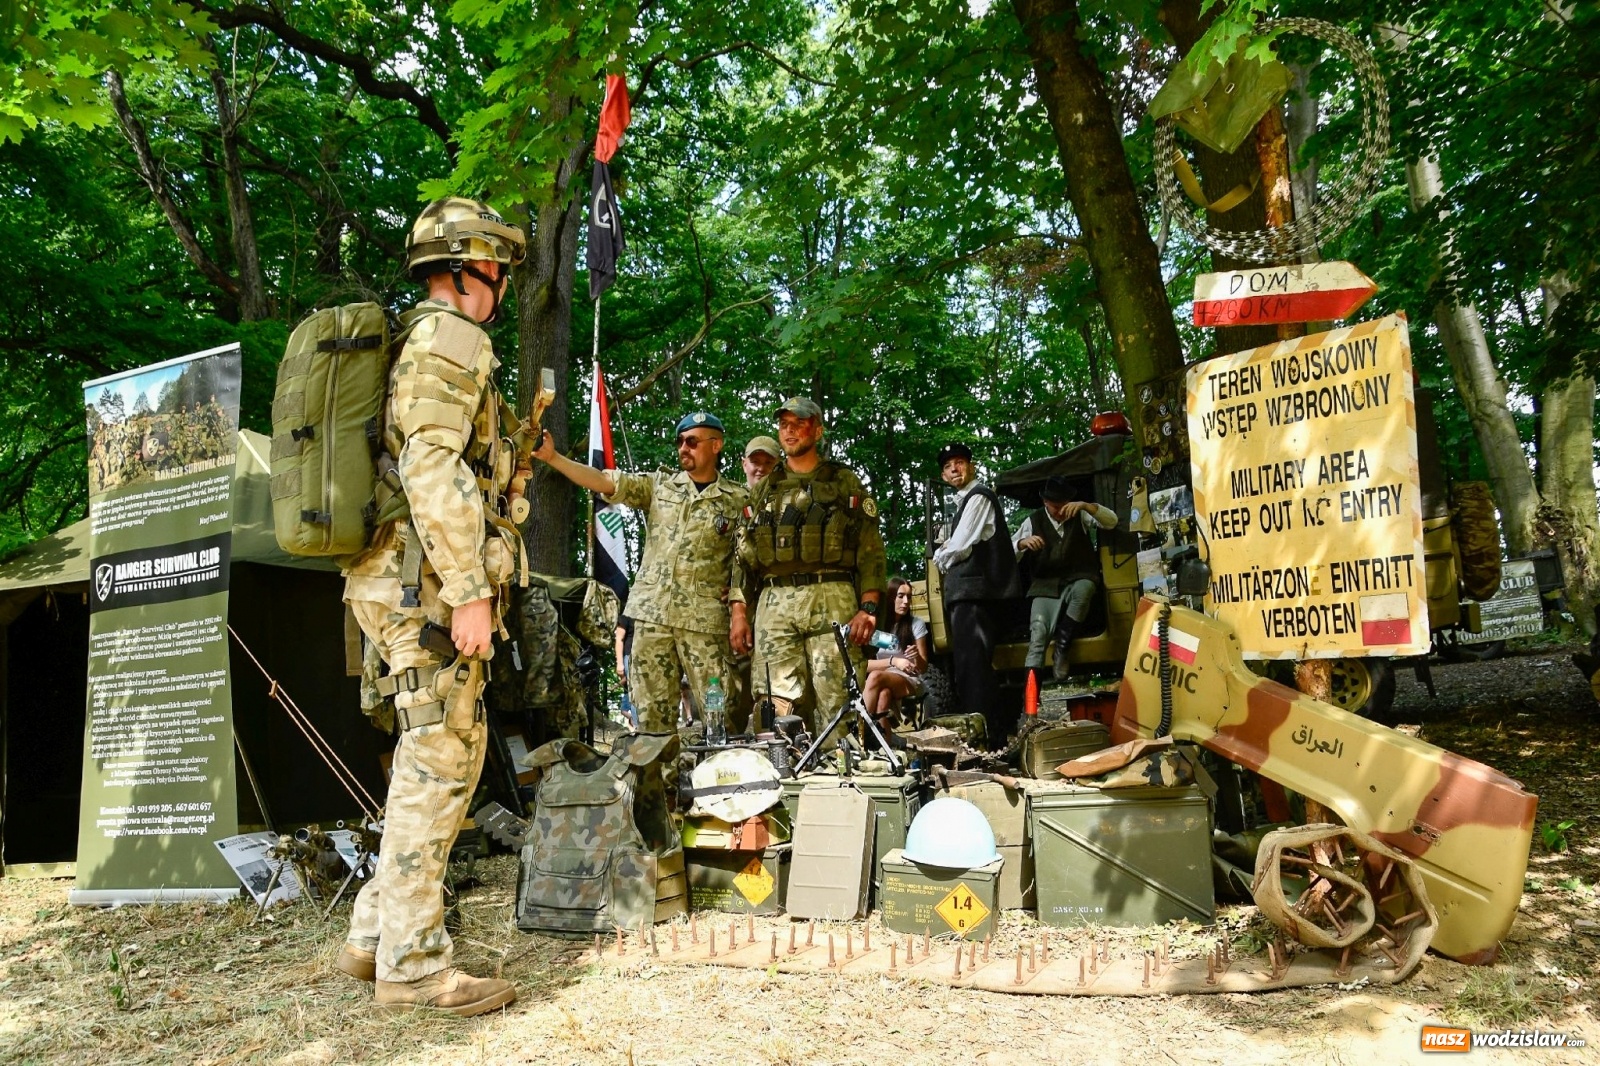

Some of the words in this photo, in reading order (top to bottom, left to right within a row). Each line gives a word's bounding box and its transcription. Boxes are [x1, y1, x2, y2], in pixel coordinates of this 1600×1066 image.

[1230, 271, 1288, 295] DOM
[1208, 364, 1262, 402] TEREN
[1270, 335, 1378, 388] WOJSKOWY
[1202, 402, 1257, 440] WSTĘP
[1265, 373, 1391, 427] WZBRONIONY
[154, 468, 184, 482] RANGER
[184, 460, 216, 475] SURVIVAL
[216, 454, 236, 468] CLUB
[1231, 458, 1306, 499] MILITARY
[1318, 449, 1370, 486] AREA
[1209, 507, 1251, 540] KEEP
[1259, 500, 1293, 534] OUT
[1340, 483, 1403, 523] ENTRY
[114, 560, 152, 580] RANGER
[153, 552, 198, 574] SURVIVAL
[199, 547, 220, 566] CLUB
[1211, 564, 1322, 604] MILITÄRZONE
[1330, 554, 1414, 594] EINTRITT
[114, 578, 177, 593] STOWARZYSZENIE
[1499, 576, 1535, 590] CLUB
[1262, 602, 1357, 638] VERBOTEN
[1291, 724, 1344, 759] العراق
[137, 805, 148, 813] 501
[148, 804, 160, 813] 939
[160, 804, 172, 812] 205
[175, 803, 187, 811] 667
[199, 802, 211, 810] 657
[952, 895, 973, 910] 1.4
[958, 919, 965, 928] G
